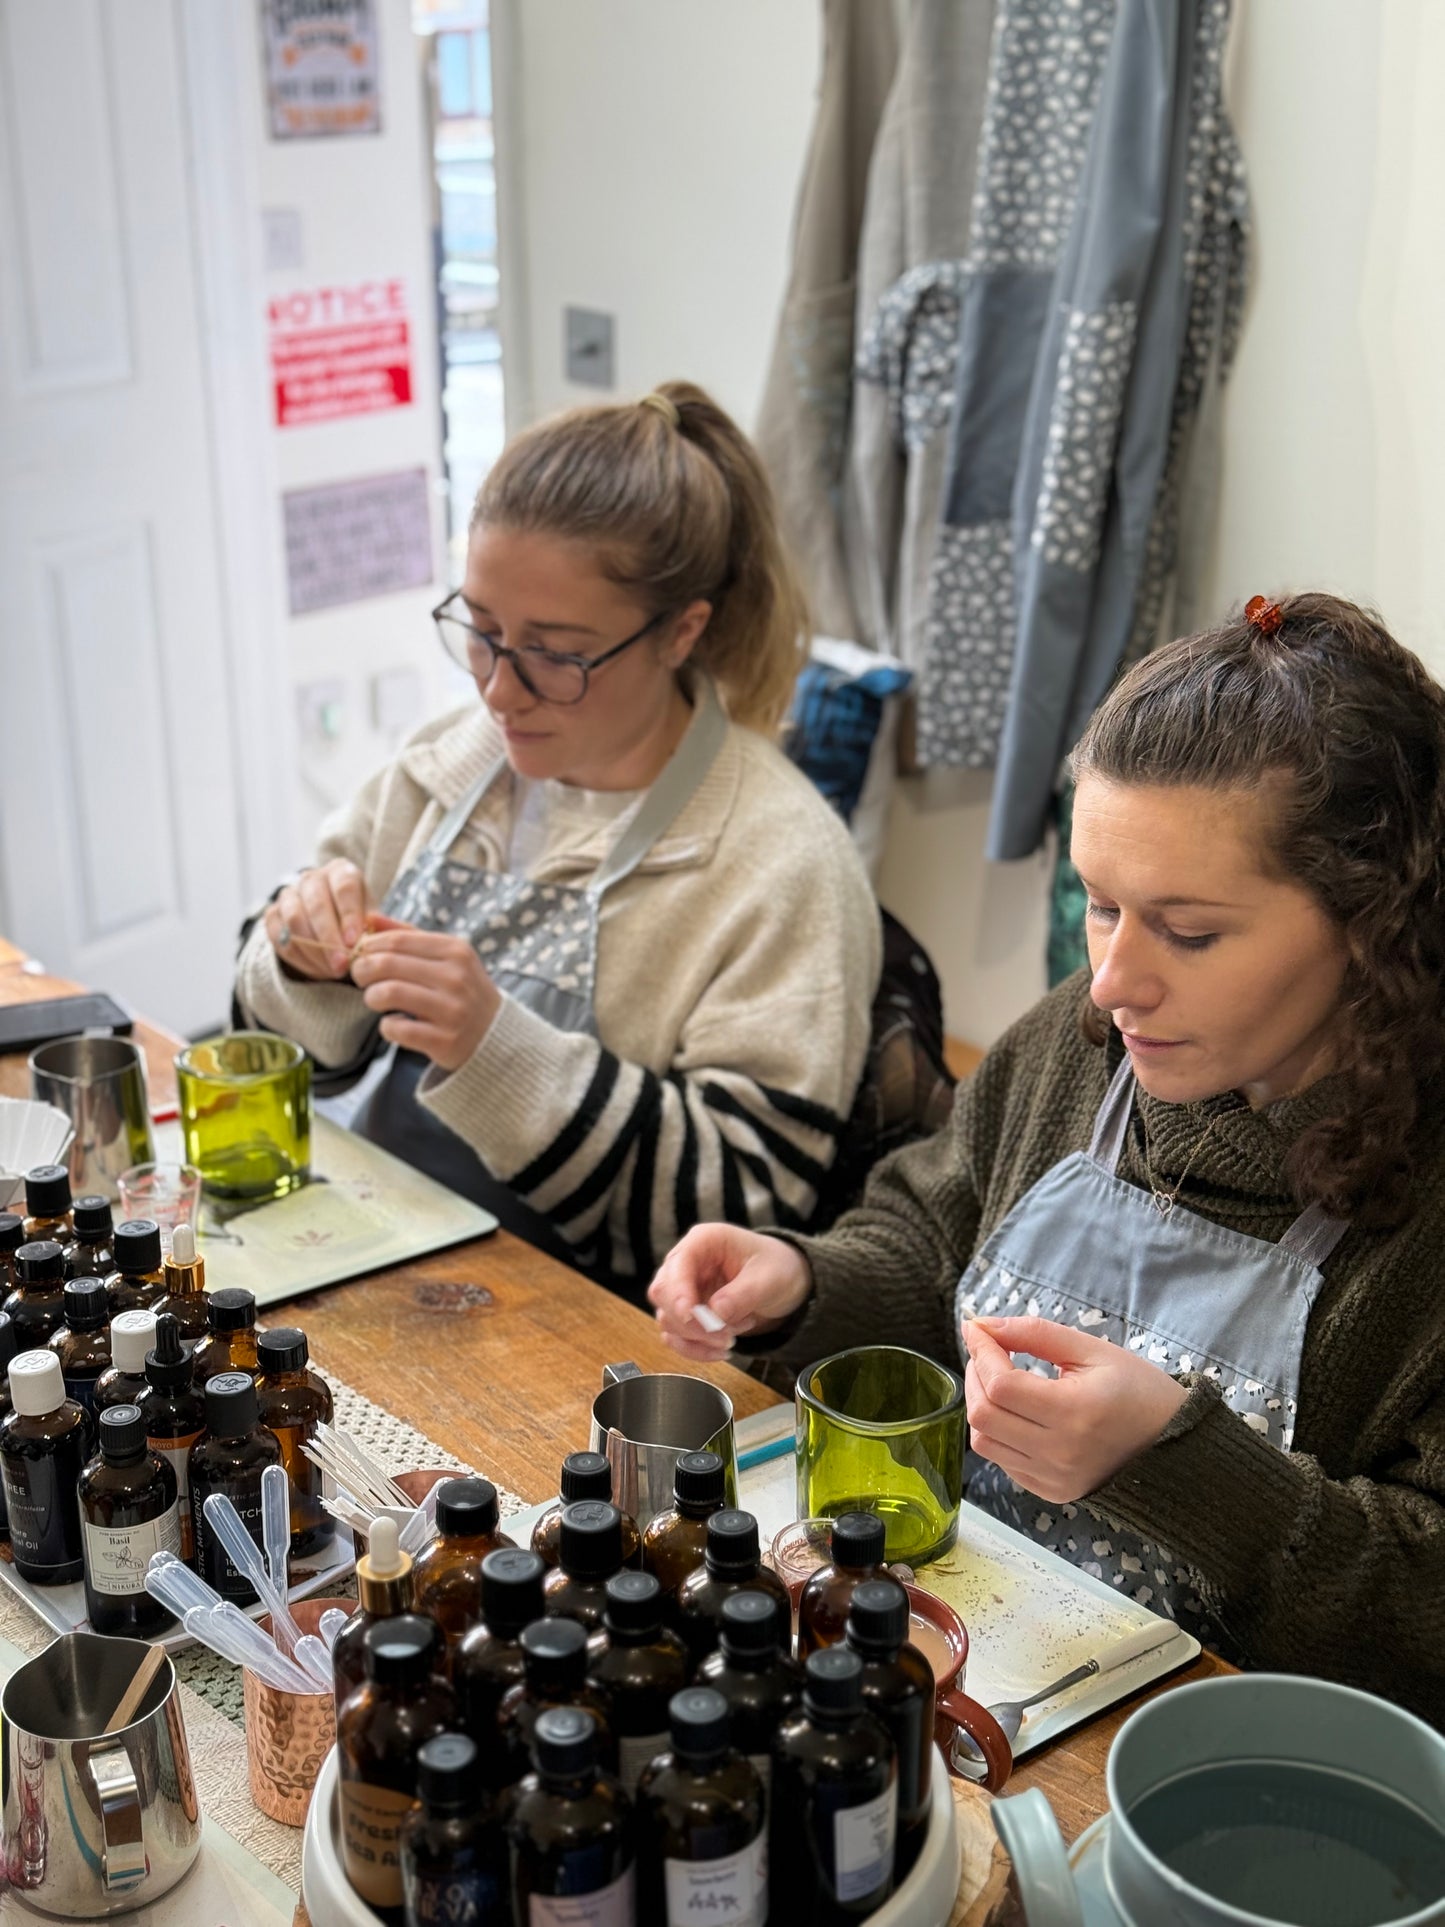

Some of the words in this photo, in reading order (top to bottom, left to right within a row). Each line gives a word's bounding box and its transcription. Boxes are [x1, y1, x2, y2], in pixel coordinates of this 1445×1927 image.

[109, 1536, 130, 1545] Basil
[26, 1541, 38, 1550] Oil
[112, 1582, 140, 1590] NIKURA
